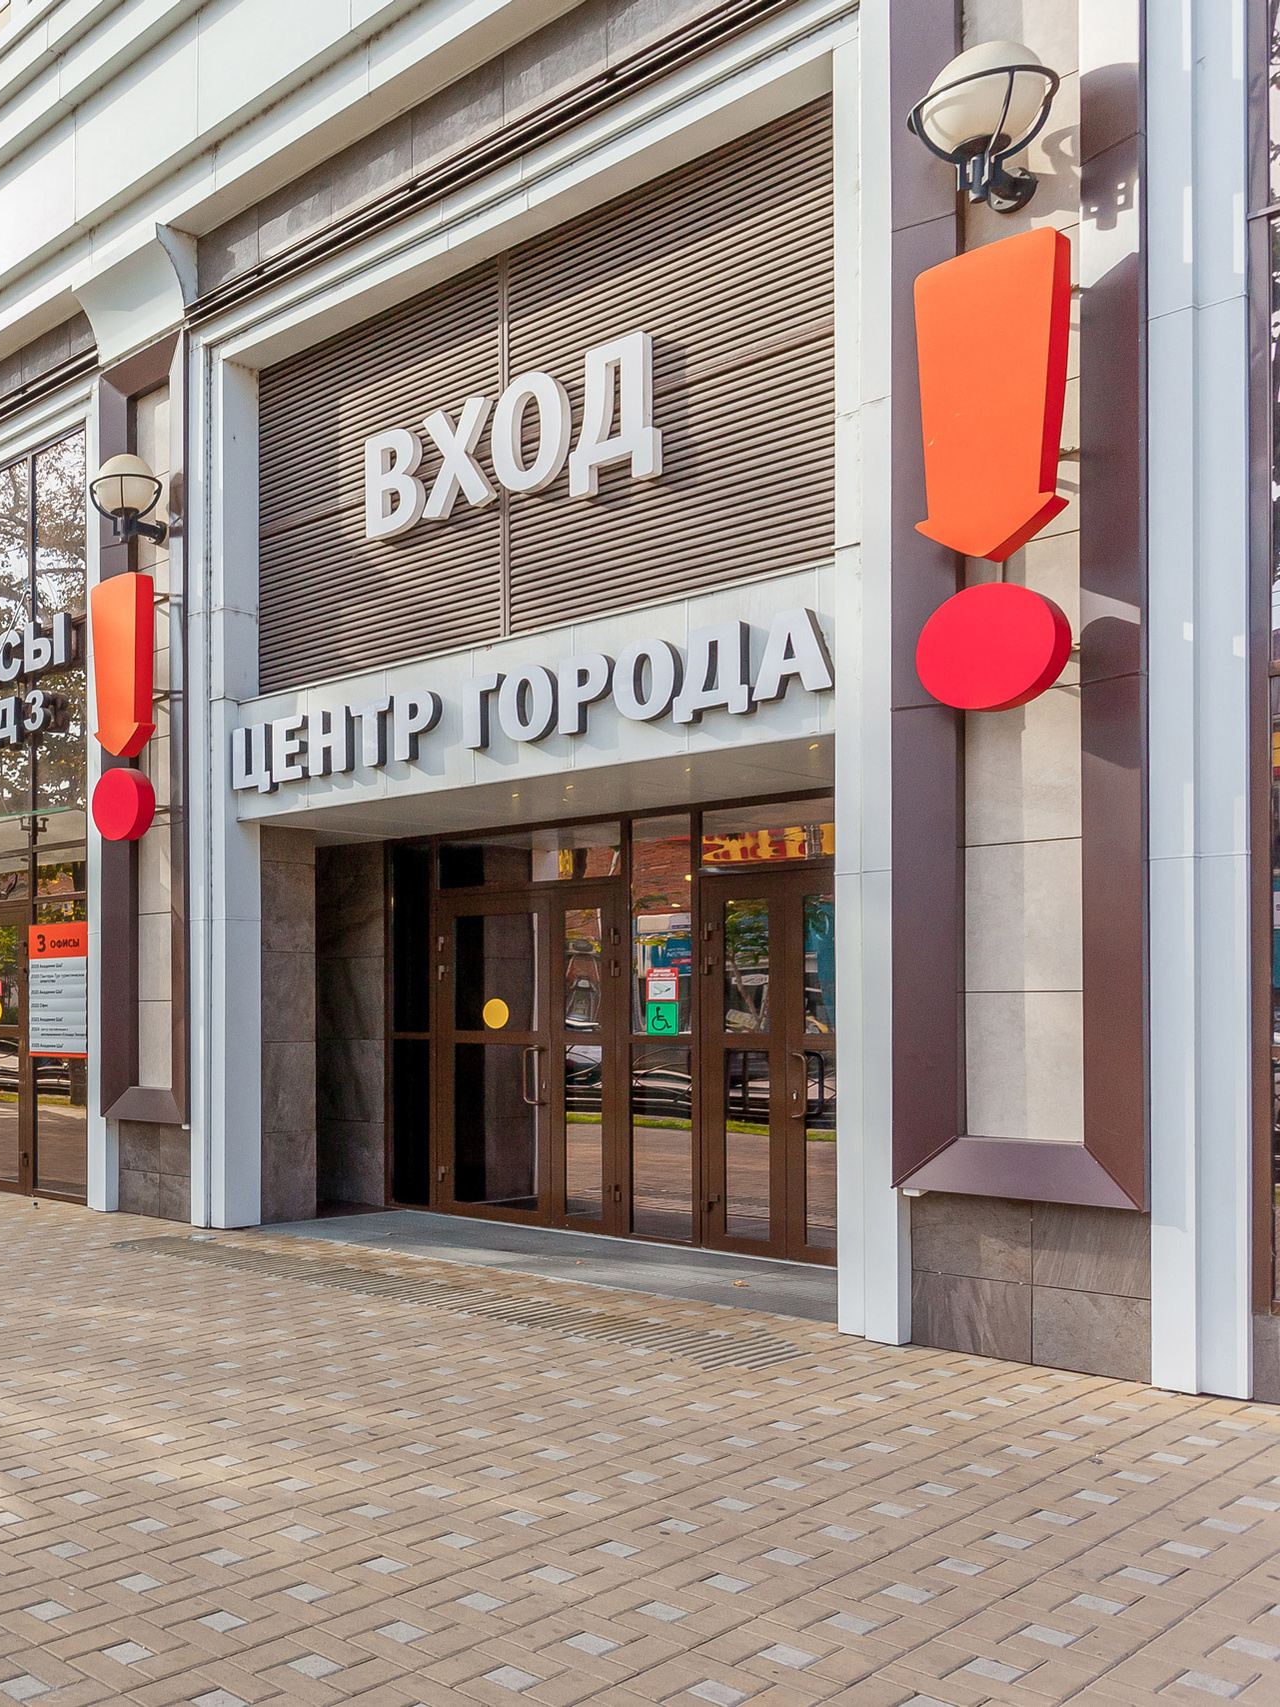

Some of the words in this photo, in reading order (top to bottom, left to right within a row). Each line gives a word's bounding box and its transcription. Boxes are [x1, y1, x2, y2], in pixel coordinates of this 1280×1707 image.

[365, 331, 662, 541] ВХОД
[23, 690, 51, 731] 3
[232, 690, 442, 793] ЦЕНТР
[463, 608, 835, 750] ГОРОДА
[36, 934, 46, 953] 3
[50, 938, 80, 949] ОФИСЫ
